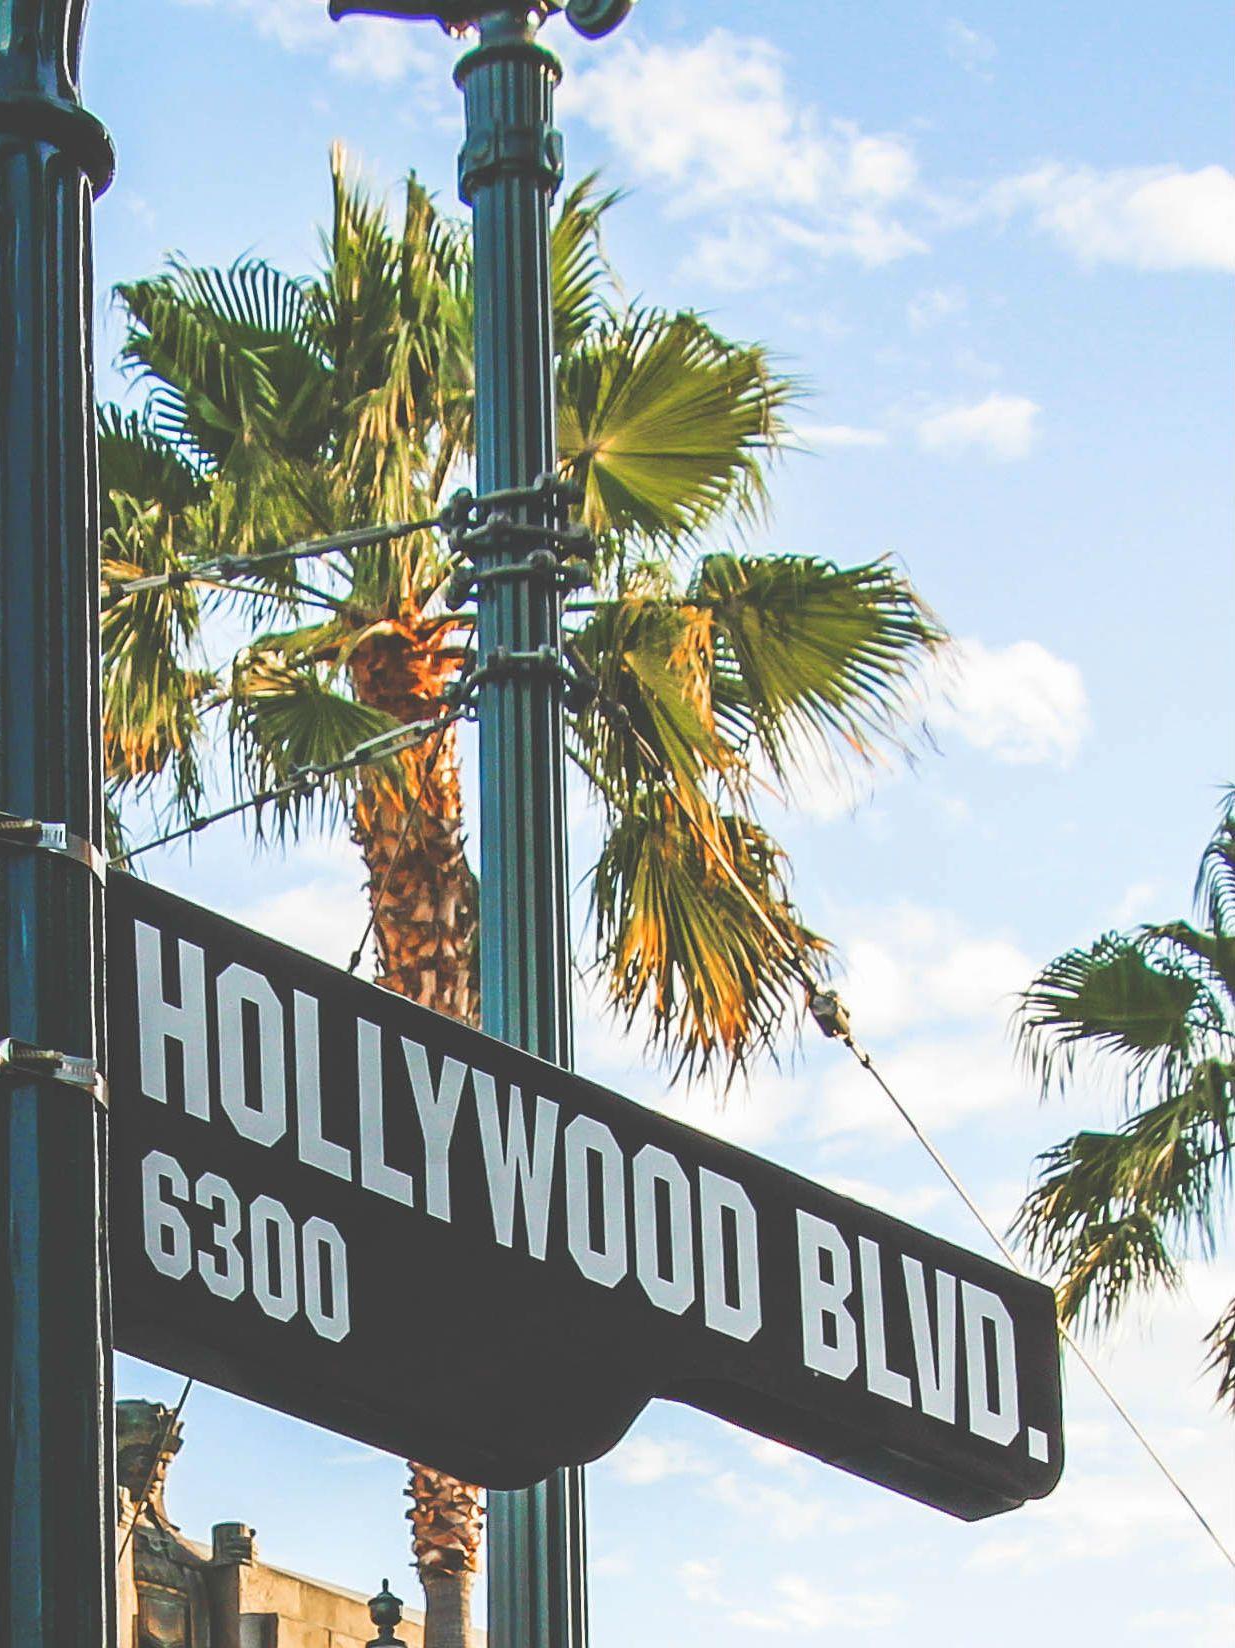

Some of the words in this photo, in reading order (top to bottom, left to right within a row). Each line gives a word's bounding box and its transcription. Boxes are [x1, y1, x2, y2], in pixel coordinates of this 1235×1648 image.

[134, 918, 763, 1343] HOLLYWOOD
[795, 1208, 1049, 1464] BLVD.
[141, 1149, 351, 1343] 6300
